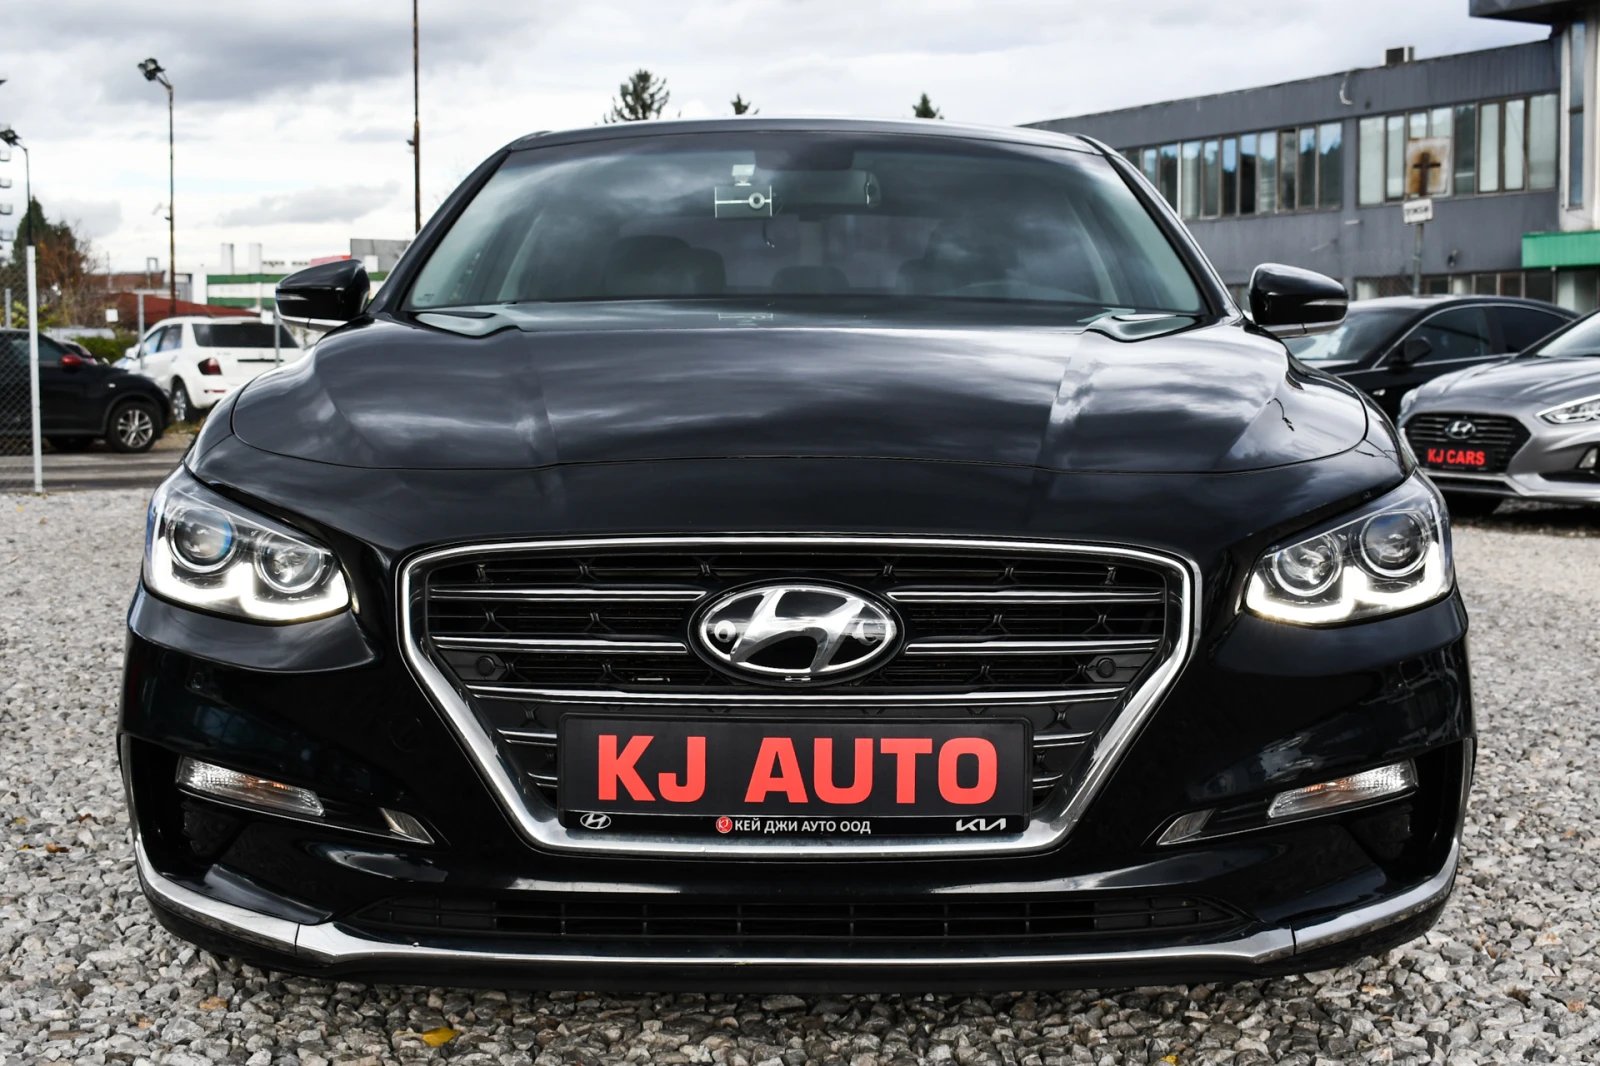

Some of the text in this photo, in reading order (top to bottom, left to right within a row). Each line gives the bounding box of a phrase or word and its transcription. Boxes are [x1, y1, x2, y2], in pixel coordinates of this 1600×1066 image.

[1427, 448, 1486, 467] KJ CARS
[597, 734, 998, 805] KJ AUTO
[734, 818, 872, 834] КЕЙ ДЖИ АУТО ООД
